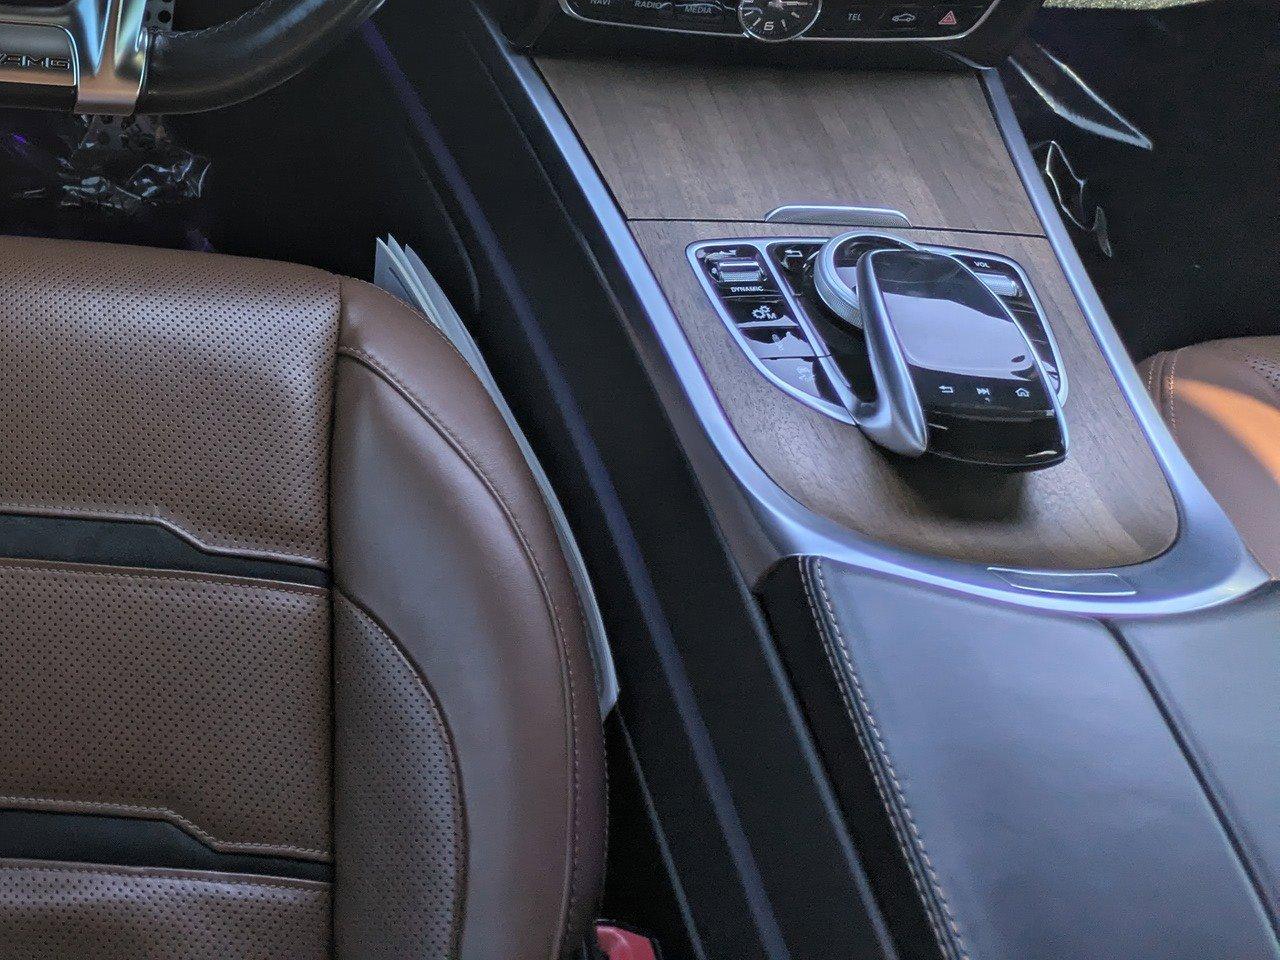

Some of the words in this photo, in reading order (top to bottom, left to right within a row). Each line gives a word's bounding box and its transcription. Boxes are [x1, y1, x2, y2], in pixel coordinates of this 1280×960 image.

[633, 0, 663, 9] RADIO
[684, 5, 712, 14] MEDIA
[848, 13, 862, 21] TEL
[6, 54, 71, 70] AMG
[973, 260, 991, 269] VOL
[730, 285, 765, 293] DYNAMIC
